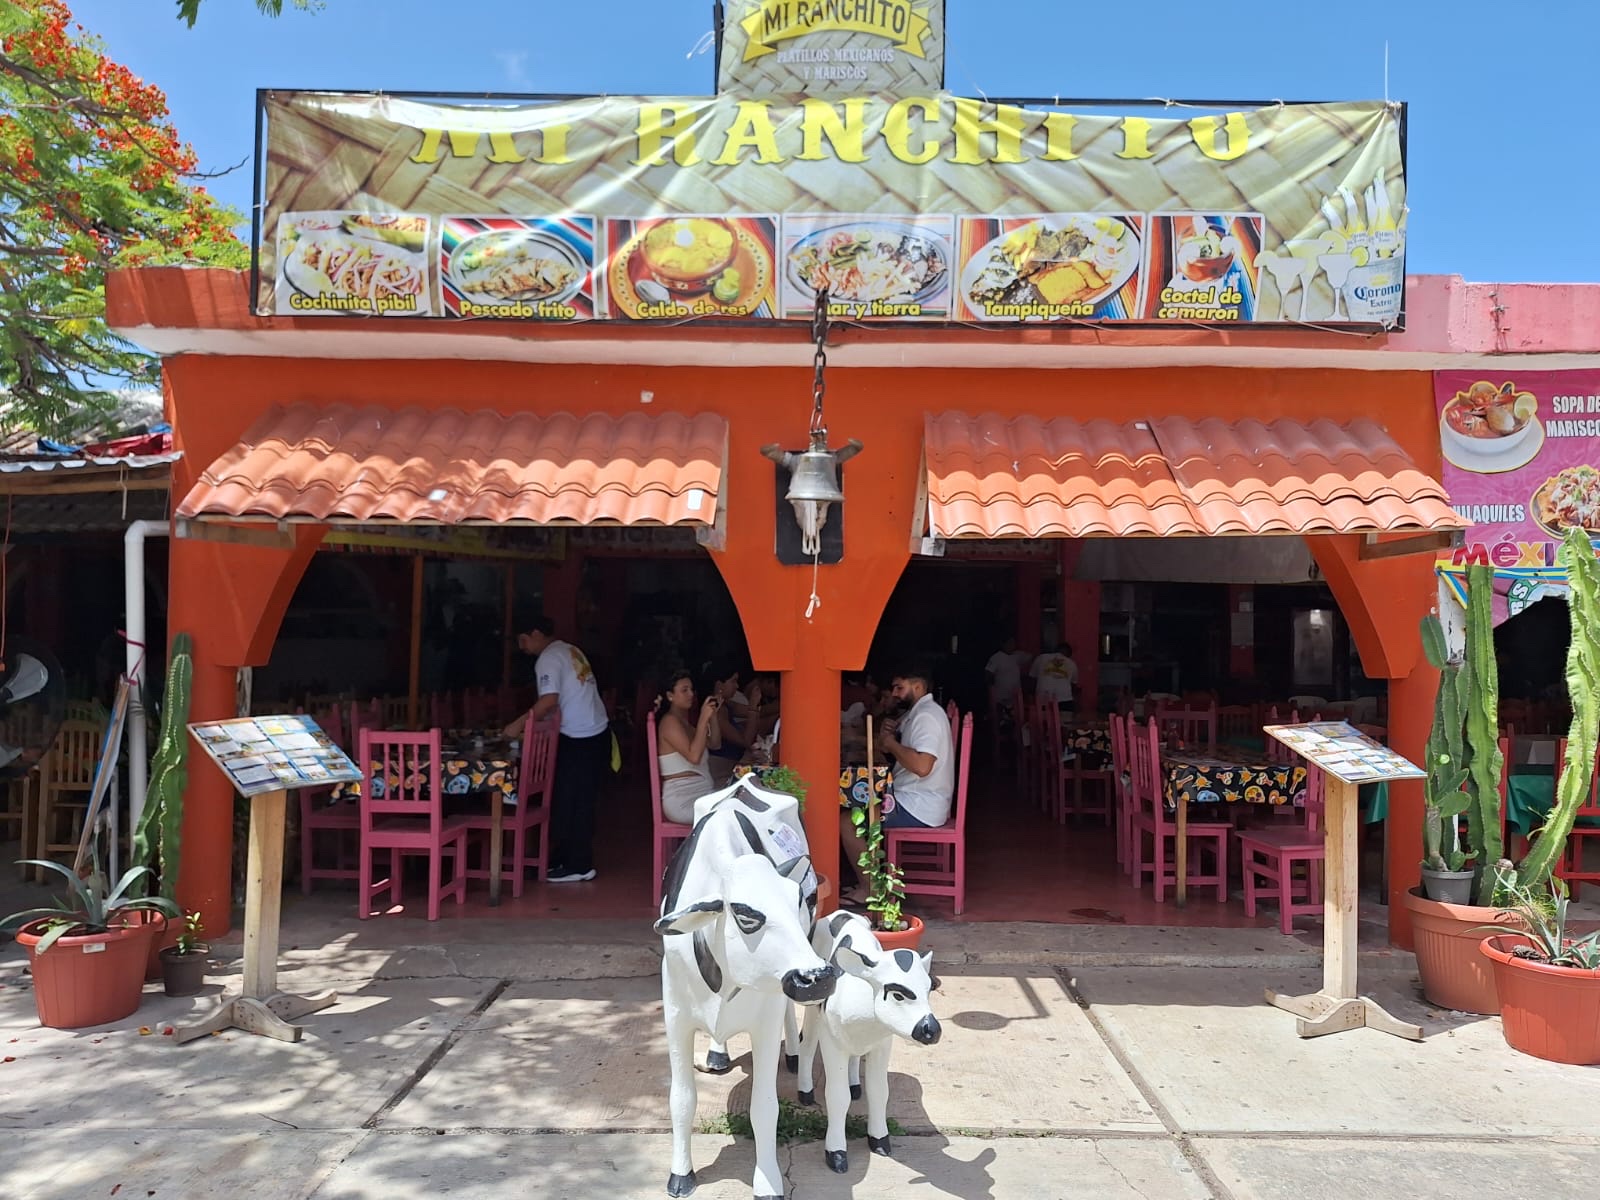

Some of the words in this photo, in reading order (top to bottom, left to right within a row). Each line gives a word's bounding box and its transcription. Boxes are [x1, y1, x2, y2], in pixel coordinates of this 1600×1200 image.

[765, 2, 789, 36] MI
[797, 0, 905, 34] RANCHITO
[777, 48, 830, 63] PLATILLOS
[834, 48, 895, 62] MEXICANOS
[803, 66, 811, 80] Y
[815, 65, 868, 80] MARISCOS
[290, 291, 373, 310] Cochinita
[377, 294, 417, 315] pibil
[1160, 286, 1216, 304] Coctel
[1219, 286, 1243, 304] de
[460, 300, 534, 318] Pescado
[538, 301, 577, 319] frito
[637, 302, 688, 318] Caldo
[693, 300, 719, 315] de
[721, 304, 747, 316] res
[827, 303, 850, 316] ar
[853, 303, 868, 319] y
[871, 299, 921, 316] tierra
[983, 300, 1095, 320] Tampiqueña
[1158, 307, 1239, 320] camaron
[1552, 395, 1585, 414] SOPA
[1587, 395, 1600, 414] DE
